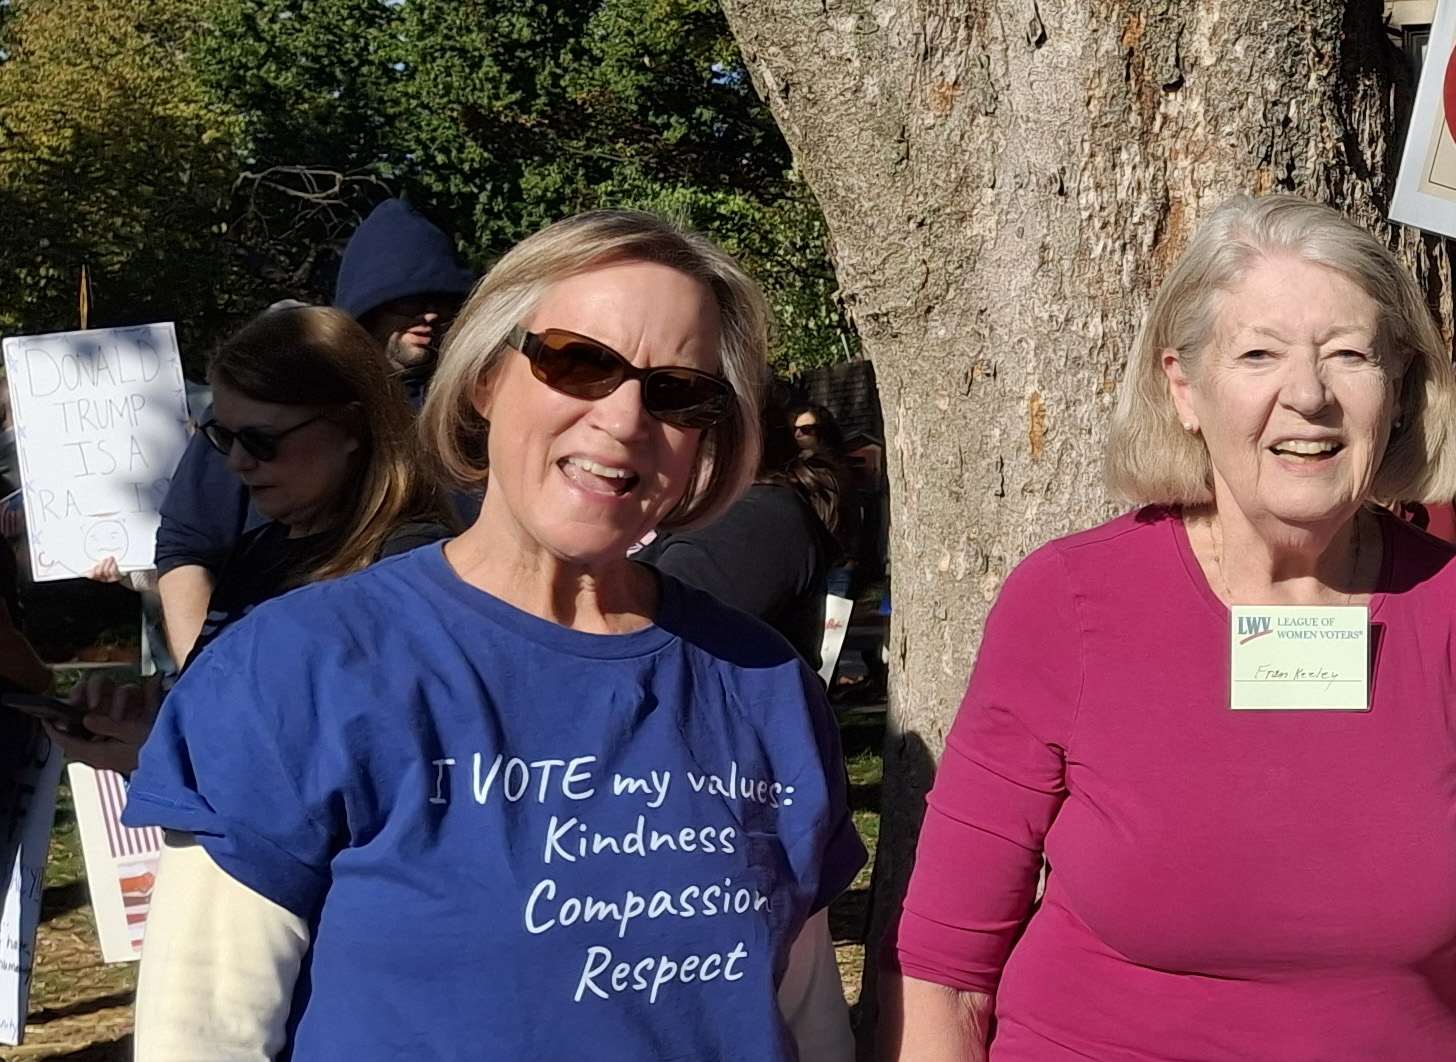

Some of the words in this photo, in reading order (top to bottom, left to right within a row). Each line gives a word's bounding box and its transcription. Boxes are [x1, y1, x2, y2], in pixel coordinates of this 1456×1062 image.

[25, 339, 160, 397] DONALD
[53, 393, 145, 433] TRUMP
[63, 440, 116, 477] IS
[129, 435, 149, 471] A
[1238, 617, 1271, 635] LWV
[1277, 618, 1318, 626] LEAGUE
[1321, 618, 1335, 627] OF
[1277, 631, 1318, 639] WOMEN
[1254, 664, 1288, 679] Fran
[430, 758, 455, 804] I
[473, 753, 596, 804] VOTE
[613, 771, 670, 807] my
[687, 761, 795, 808] values:
[544, 816, 736, 864] Kindness
[525, 877, 772, 938] Compassion
[574, 942, 748, 1002] Respect
